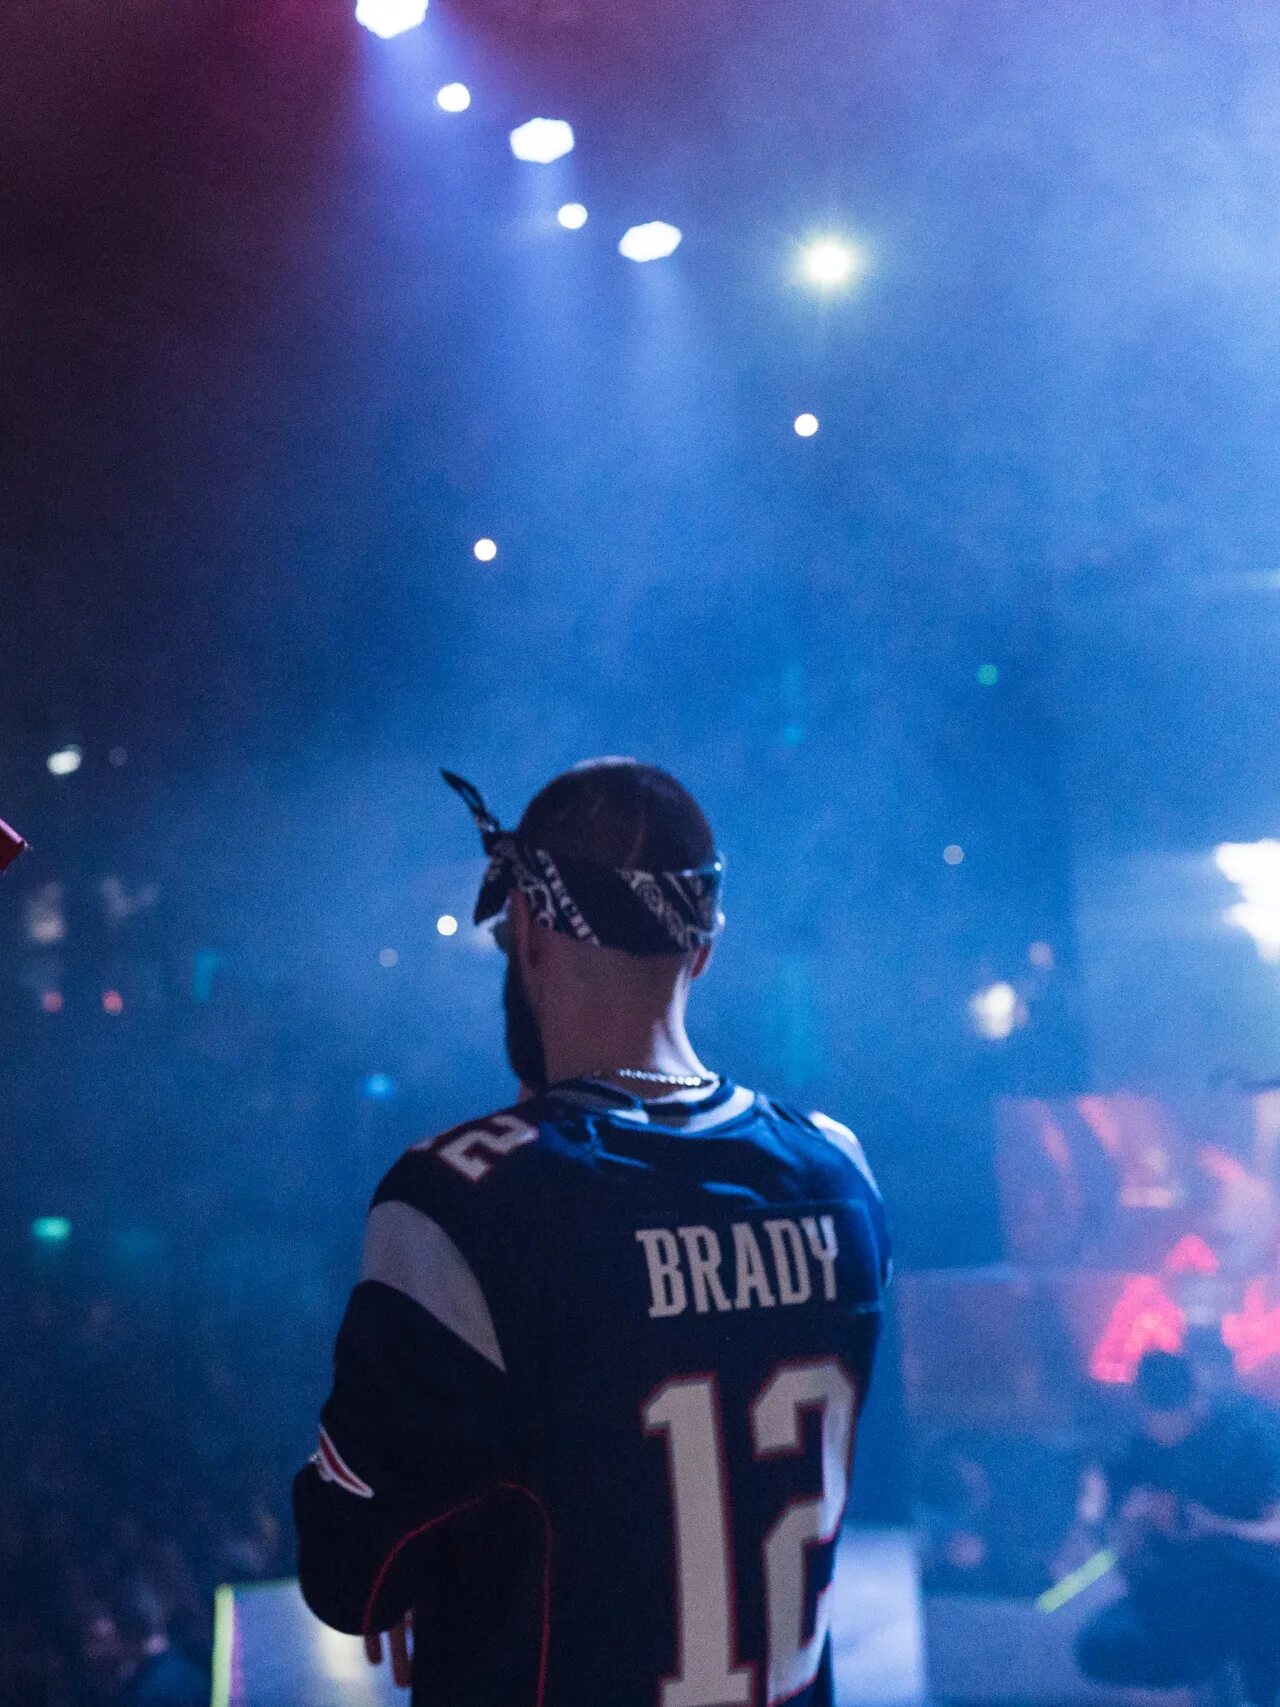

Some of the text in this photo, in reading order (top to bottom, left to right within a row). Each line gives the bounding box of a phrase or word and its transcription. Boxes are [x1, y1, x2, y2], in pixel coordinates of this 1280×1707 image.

[410, 1113, 540, 1184] 2
[635, 1214, 839, 1318] BRADY
[640, 1356, 858, 1707] 12
